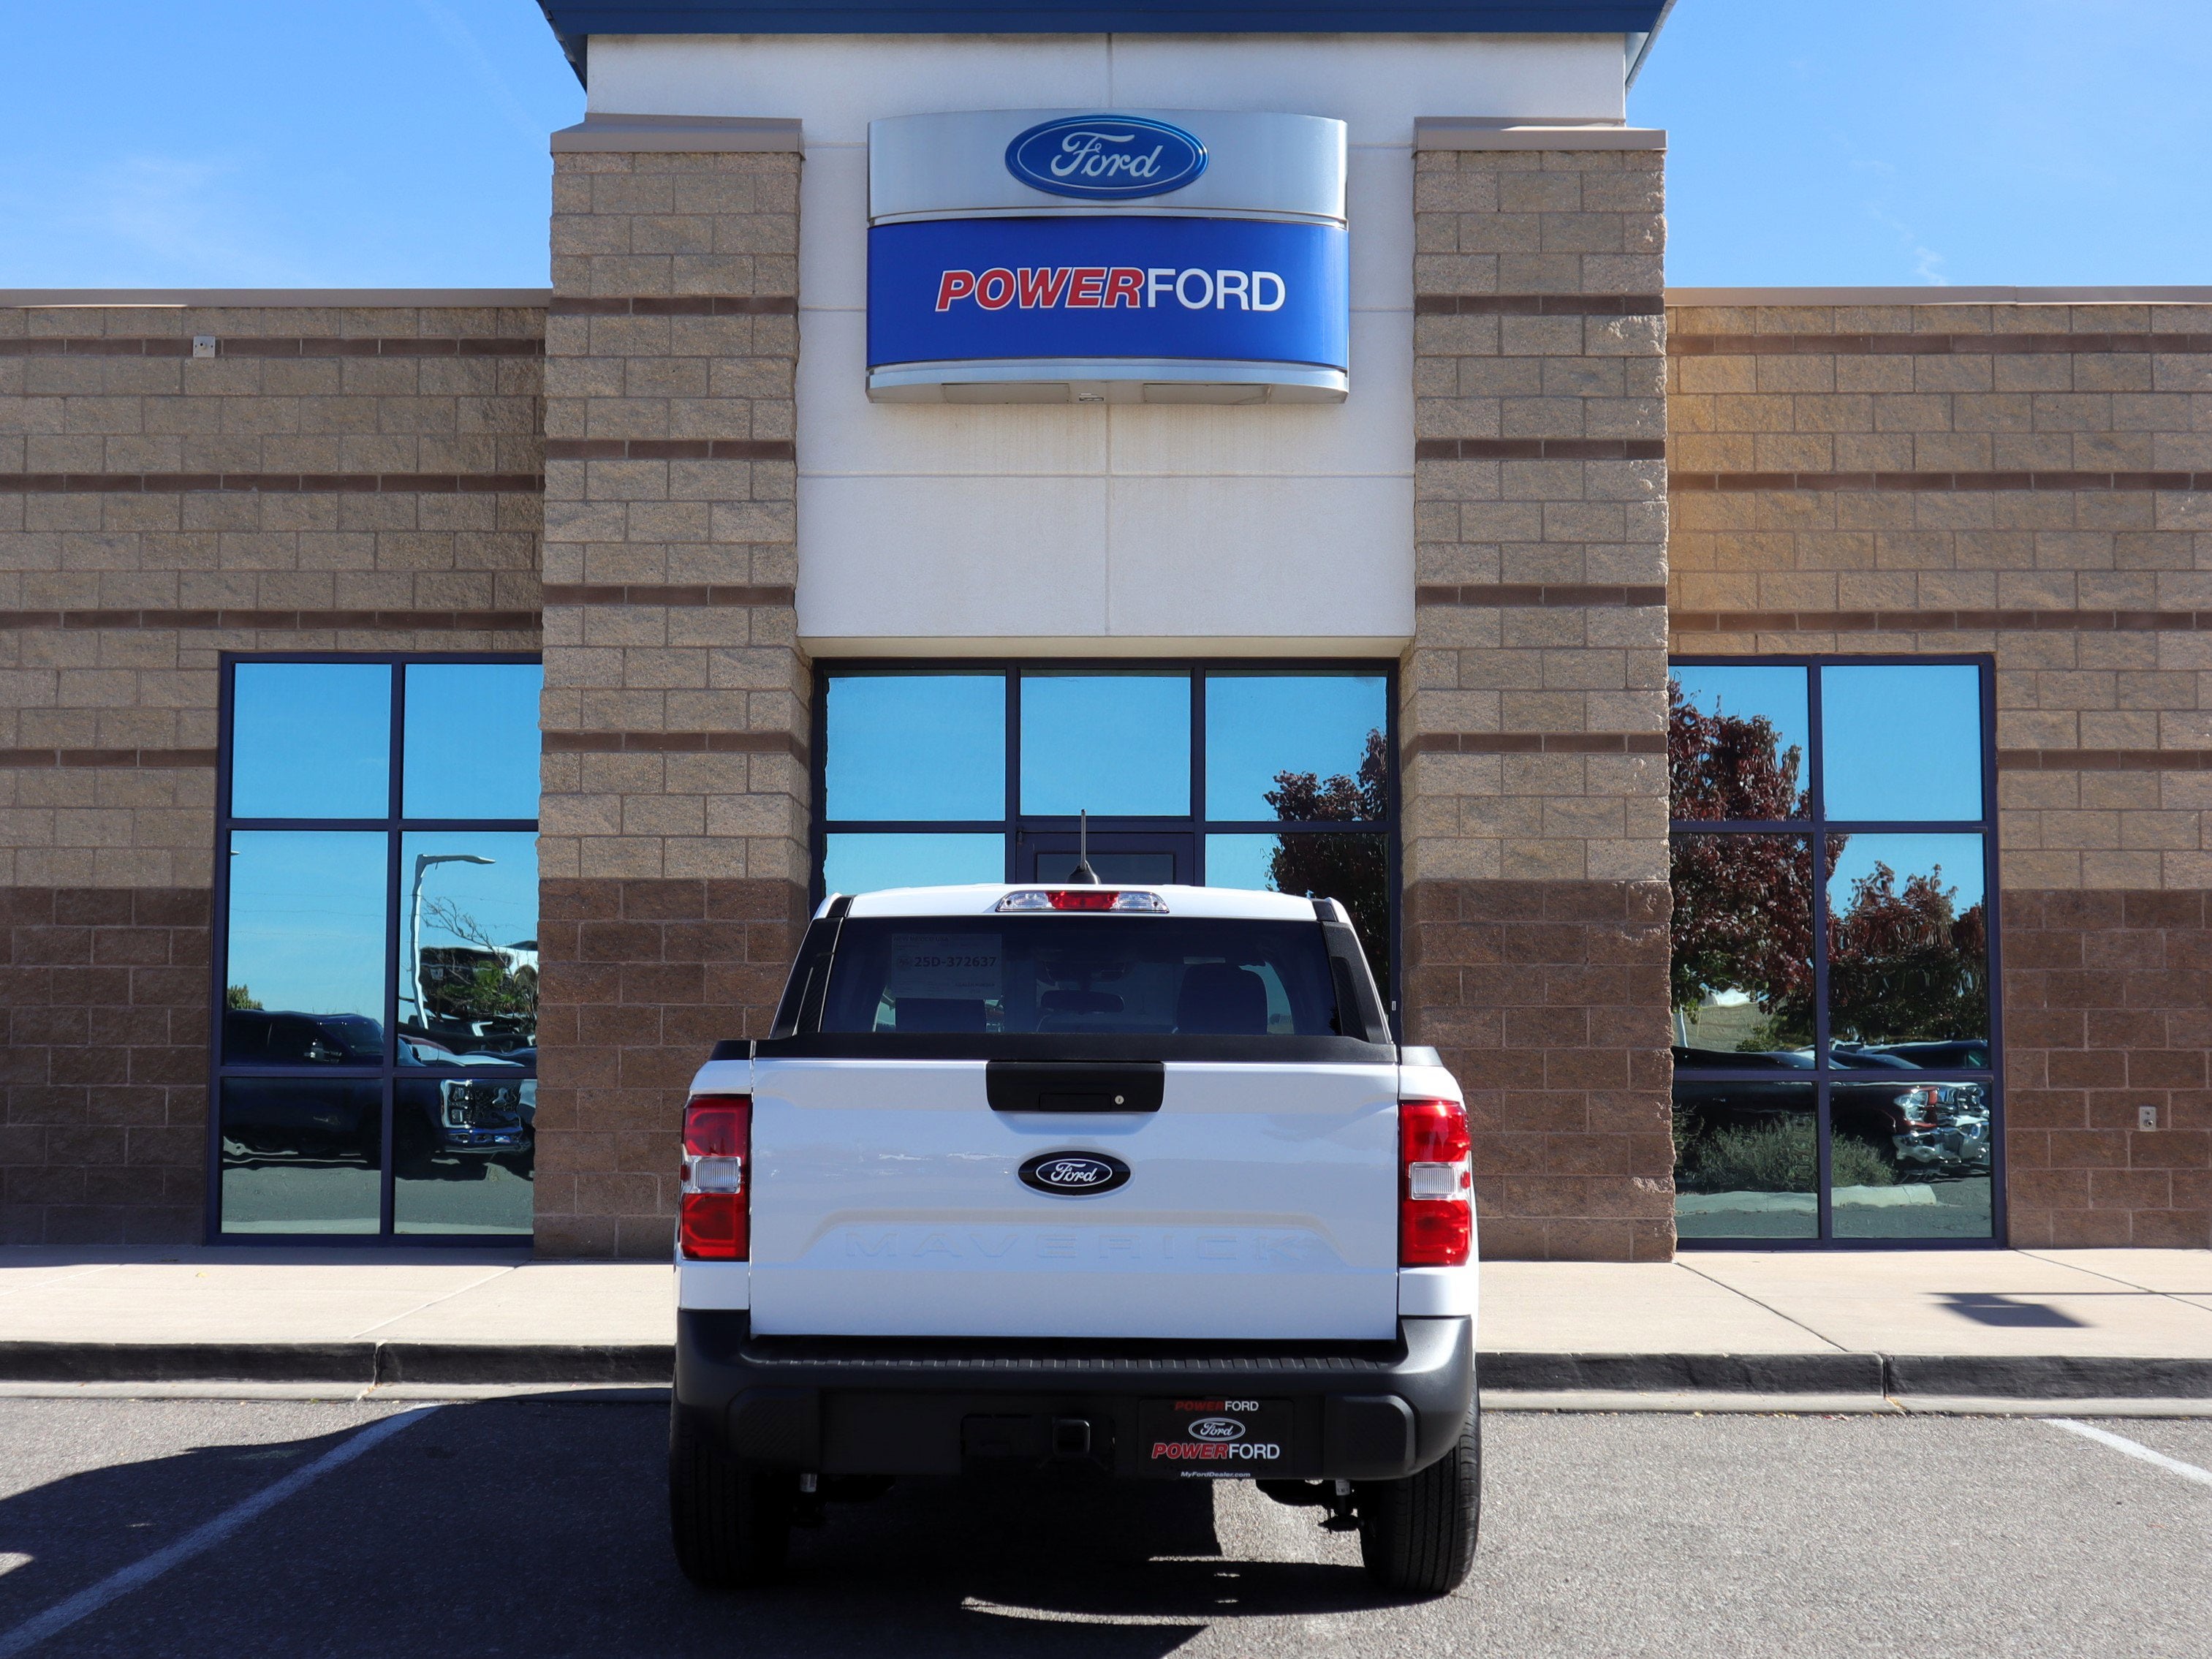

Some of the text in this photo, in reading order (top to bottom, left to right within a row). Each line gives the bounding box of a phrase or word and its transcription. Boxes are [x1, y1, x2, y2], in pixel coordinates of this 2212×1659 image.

[1050, 132, 1163, 178] Ford
[935, 266, 1287, 312] POWERFORD
[914, 956, 997, 967] 25D-372637
[1050, 1162, 1097, 1183] Ford
[845, 1231, 1307, 1262] MAVERICK
[1174, 1400, 1260, 1412] POWERFORD
[1200, 1421, 1234, 1437] Ford
[1151, 1443, 1281, 1459] POWERFORD
[1180, 1470, 1251, 1478] MyFordDealer.com
